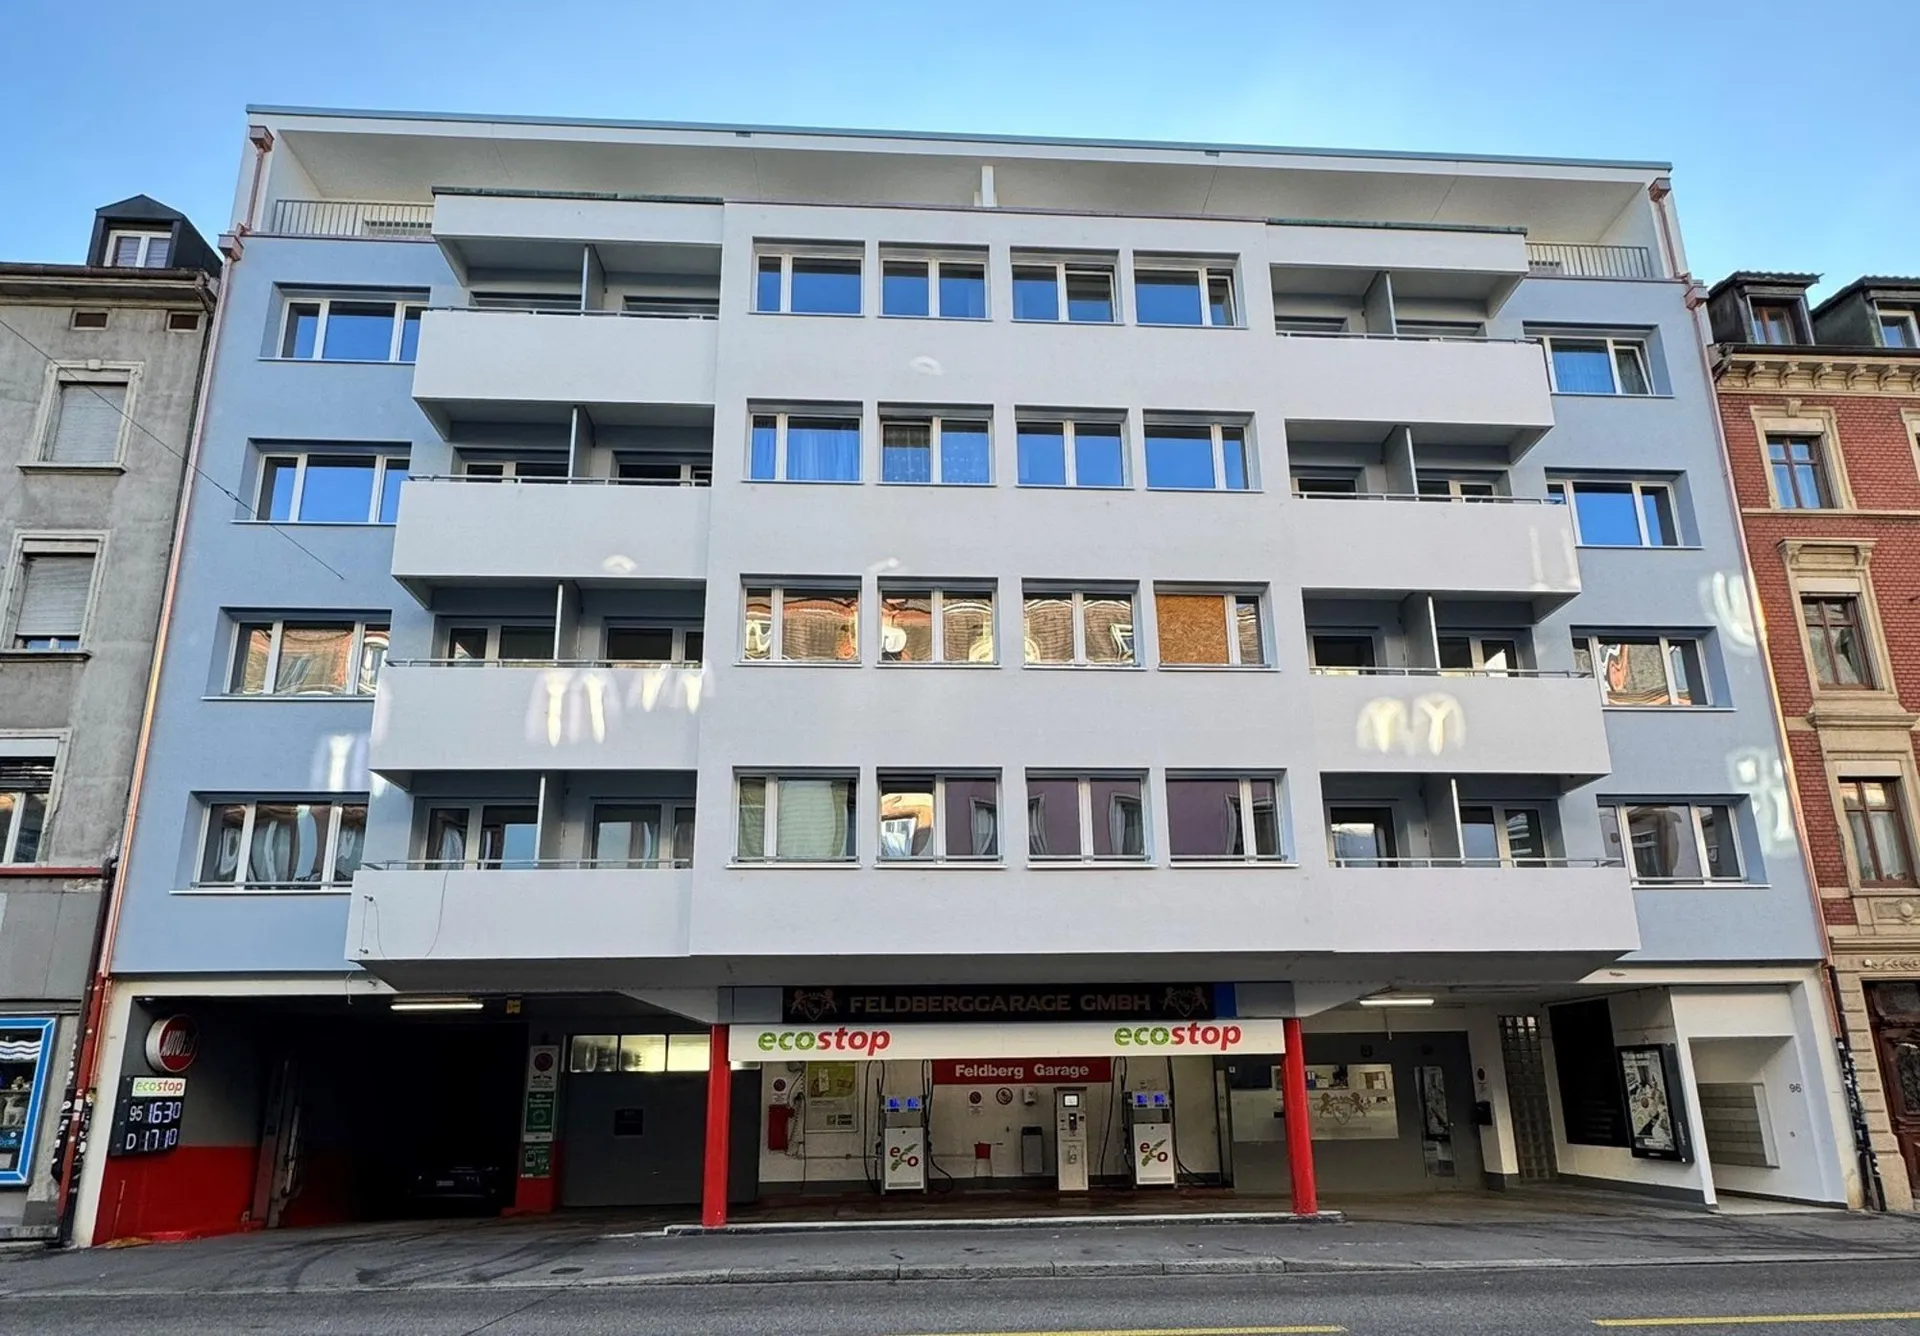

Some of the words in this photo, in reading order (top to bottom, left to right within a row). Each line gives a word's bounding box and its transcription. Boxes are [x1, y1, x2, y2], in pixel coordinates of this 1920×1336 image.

[850, 994, 1072, 1013] FELDBERGGARAGE
[1080, 994, 1151, 1012] GMBH
[758, 1027, 890, 1056] ecostop
[1114, 1021, 1242, 1051] ecostop
[955, 1064, 1024, 1079] Feldberg
[1033, 1063, 1090, 1078] Garage
[135, 1081, 183, 1094] ecostop
[1789, 1083, 1802, 1093] 96
[129, 1105, 143, 1122] 95
[125, 1133, 137, 1150] D
[890, 1146, 919, 1167] eco
[1139, 1142, 1168, 1163] eco
